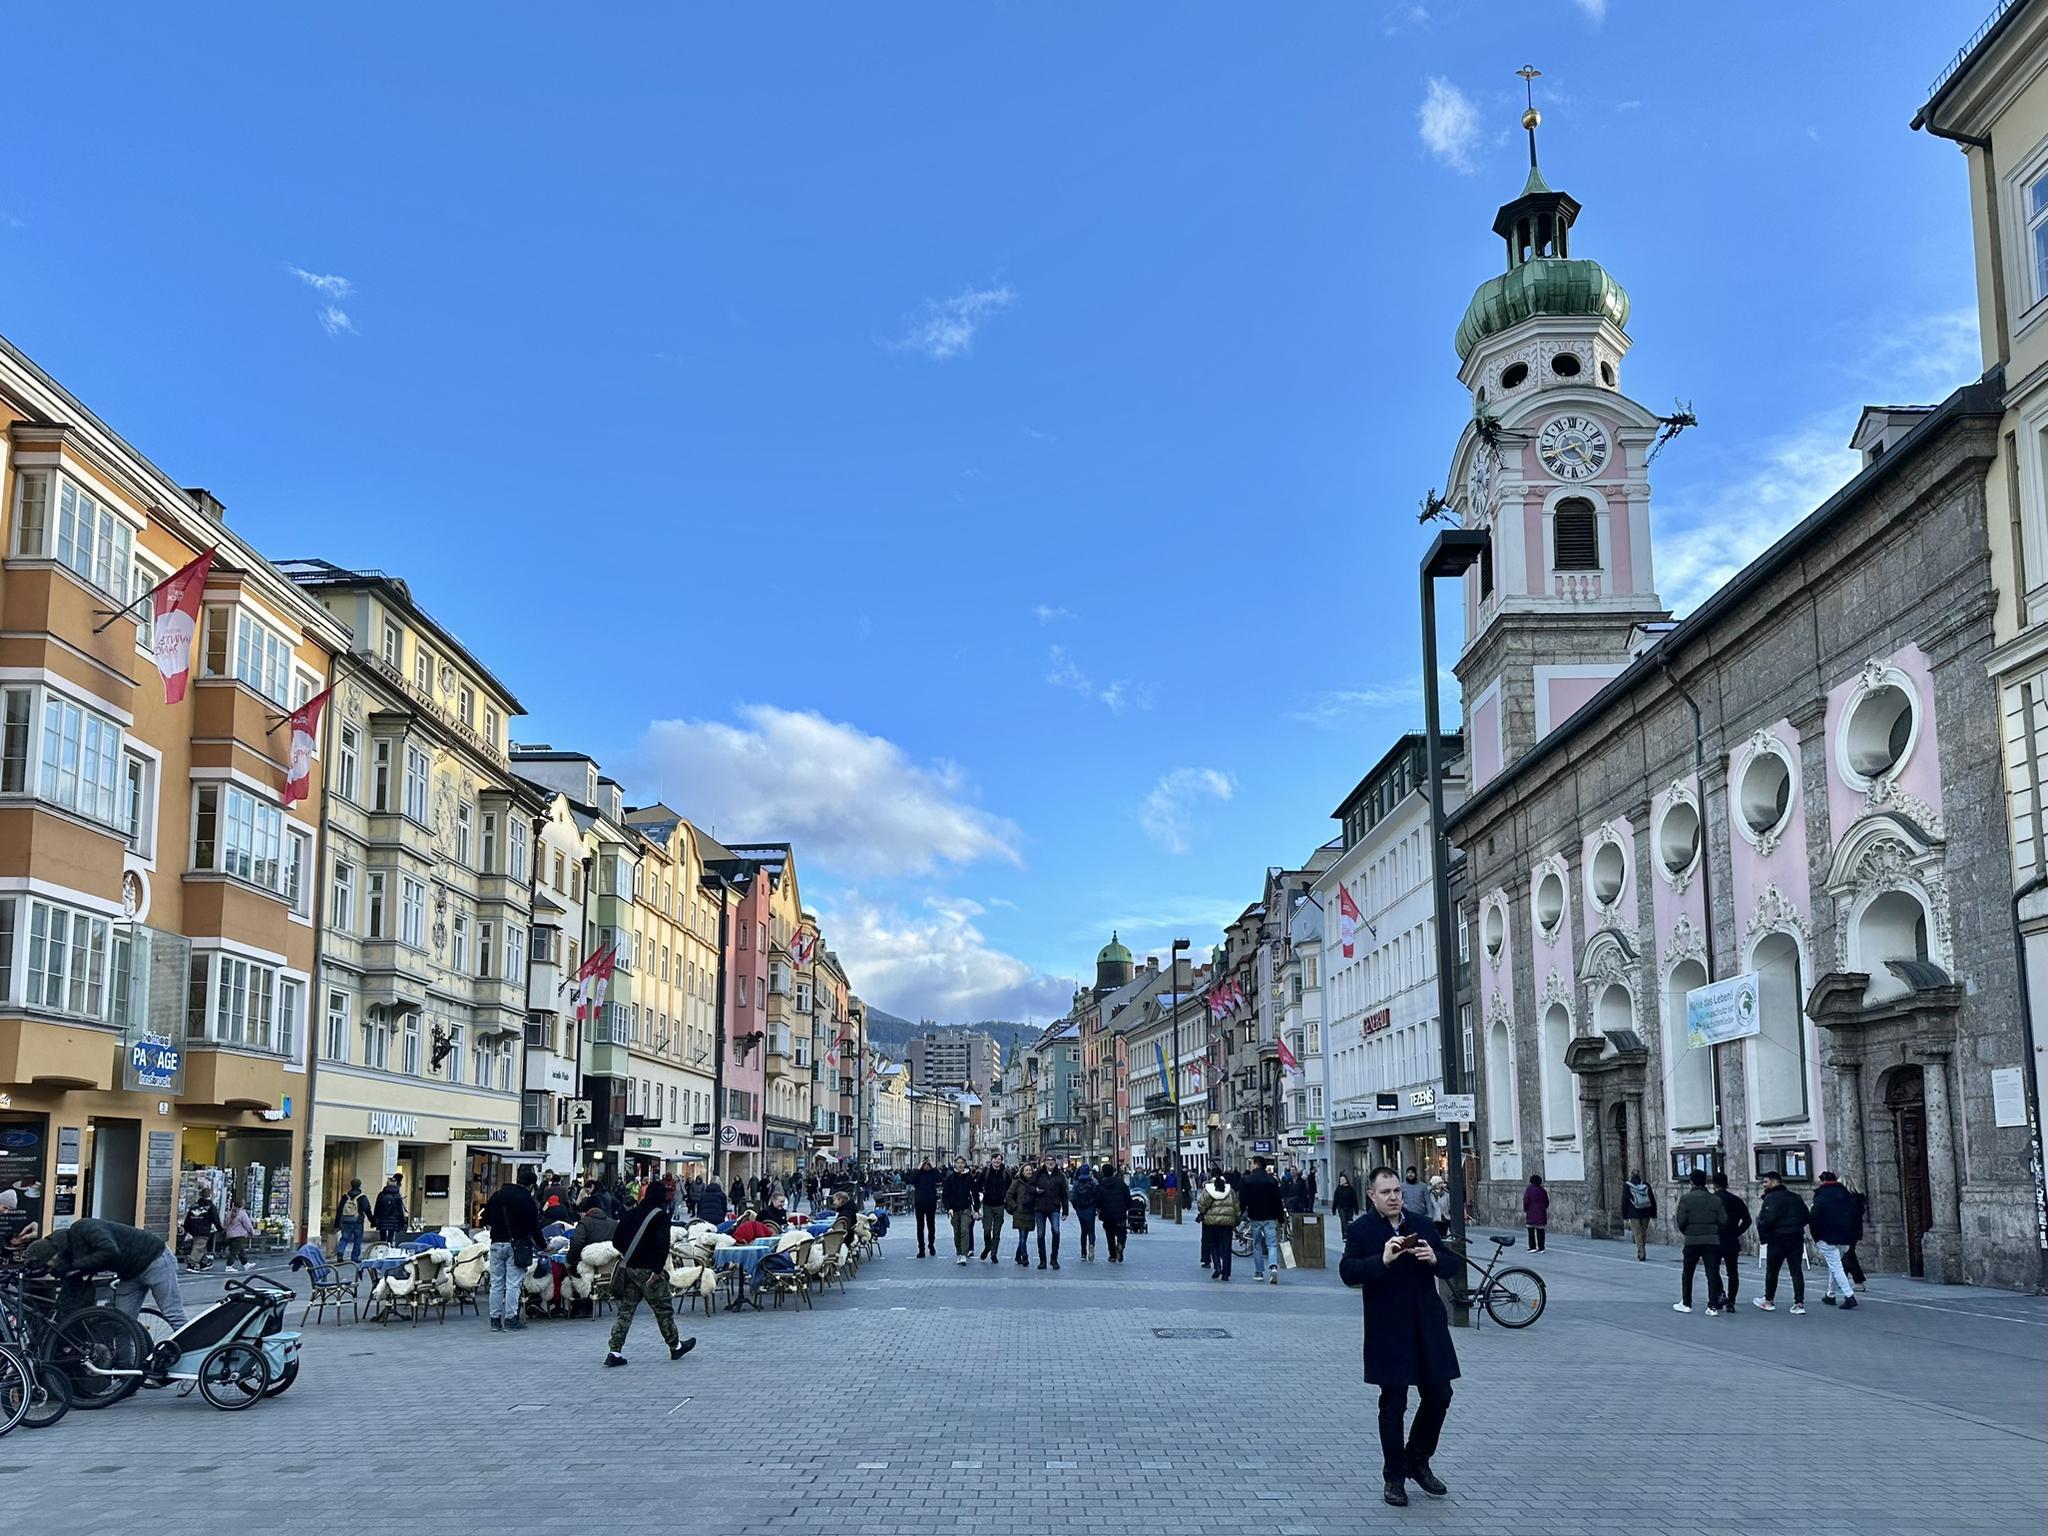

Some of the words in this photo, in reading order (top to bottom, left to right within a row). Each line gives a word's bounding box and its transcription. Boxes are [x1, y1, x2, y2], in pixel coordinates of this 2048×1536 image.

[1713, 989, 1734, 1005] Leben!
[370, 1111, 418, 1137] HUMANIC
[737, 1132, 760, 1148] TYROLIA
